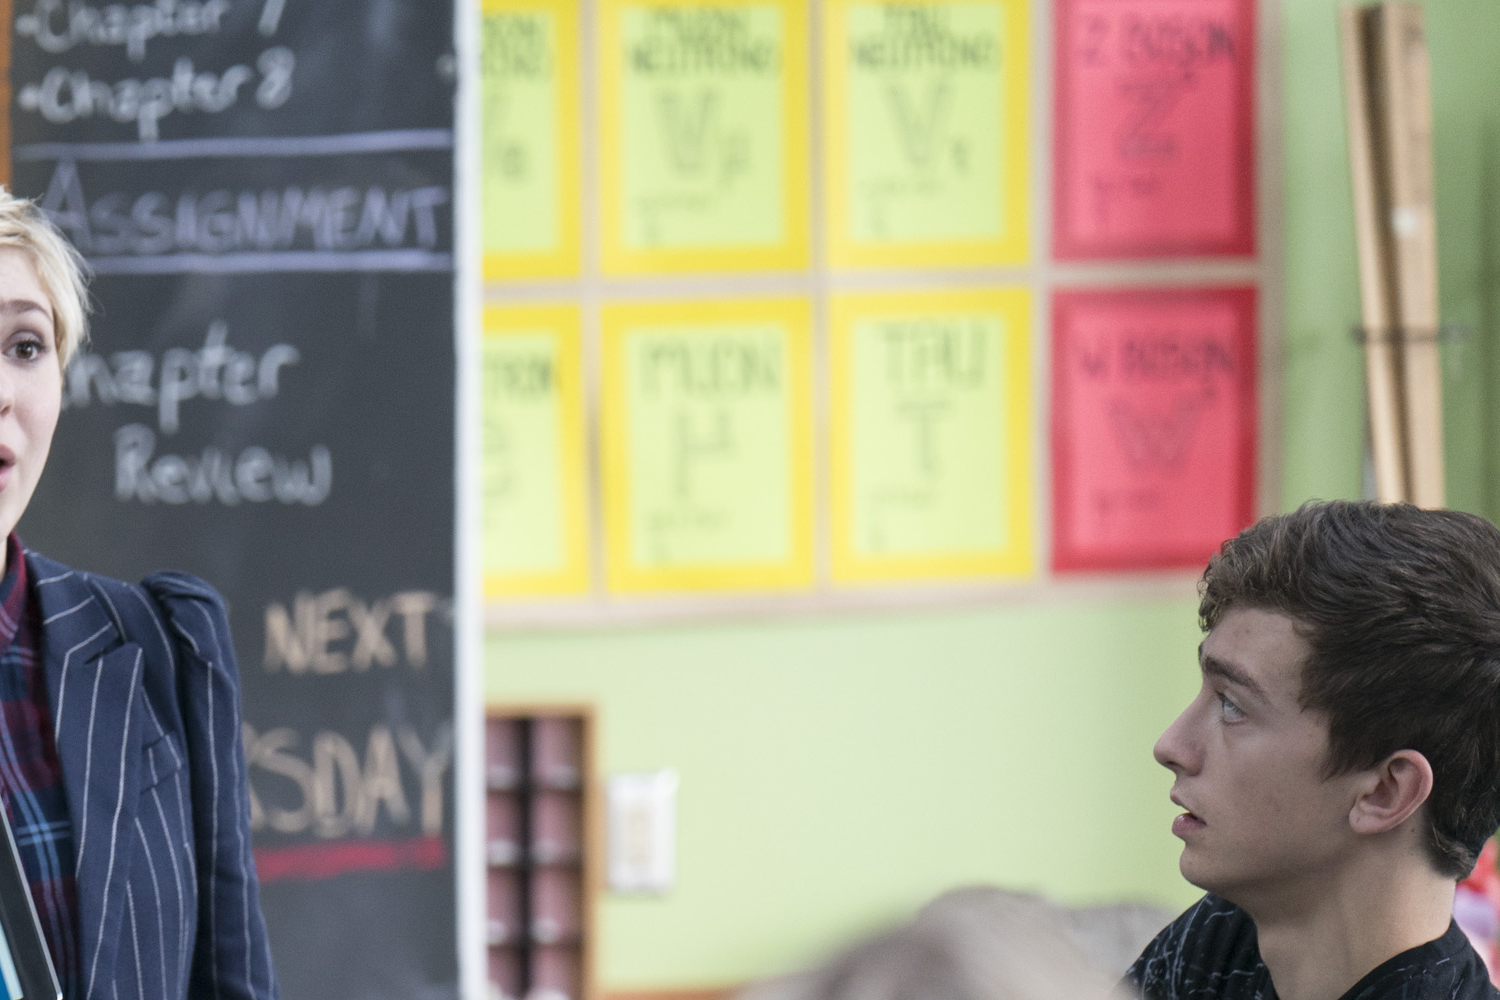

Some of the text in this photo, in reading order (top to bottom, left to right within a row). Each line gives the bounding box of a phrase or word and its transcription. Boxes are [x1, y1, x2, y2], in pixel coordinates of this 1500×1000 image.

[38, 46, 296, 142] Chapter 8
[44, 157, 448, 256] ASSIGNMENT
[62, 318, 299, 436] hapter
[114, 423, 332, 507] Review
[263, 587, 438, 675] NEXT
